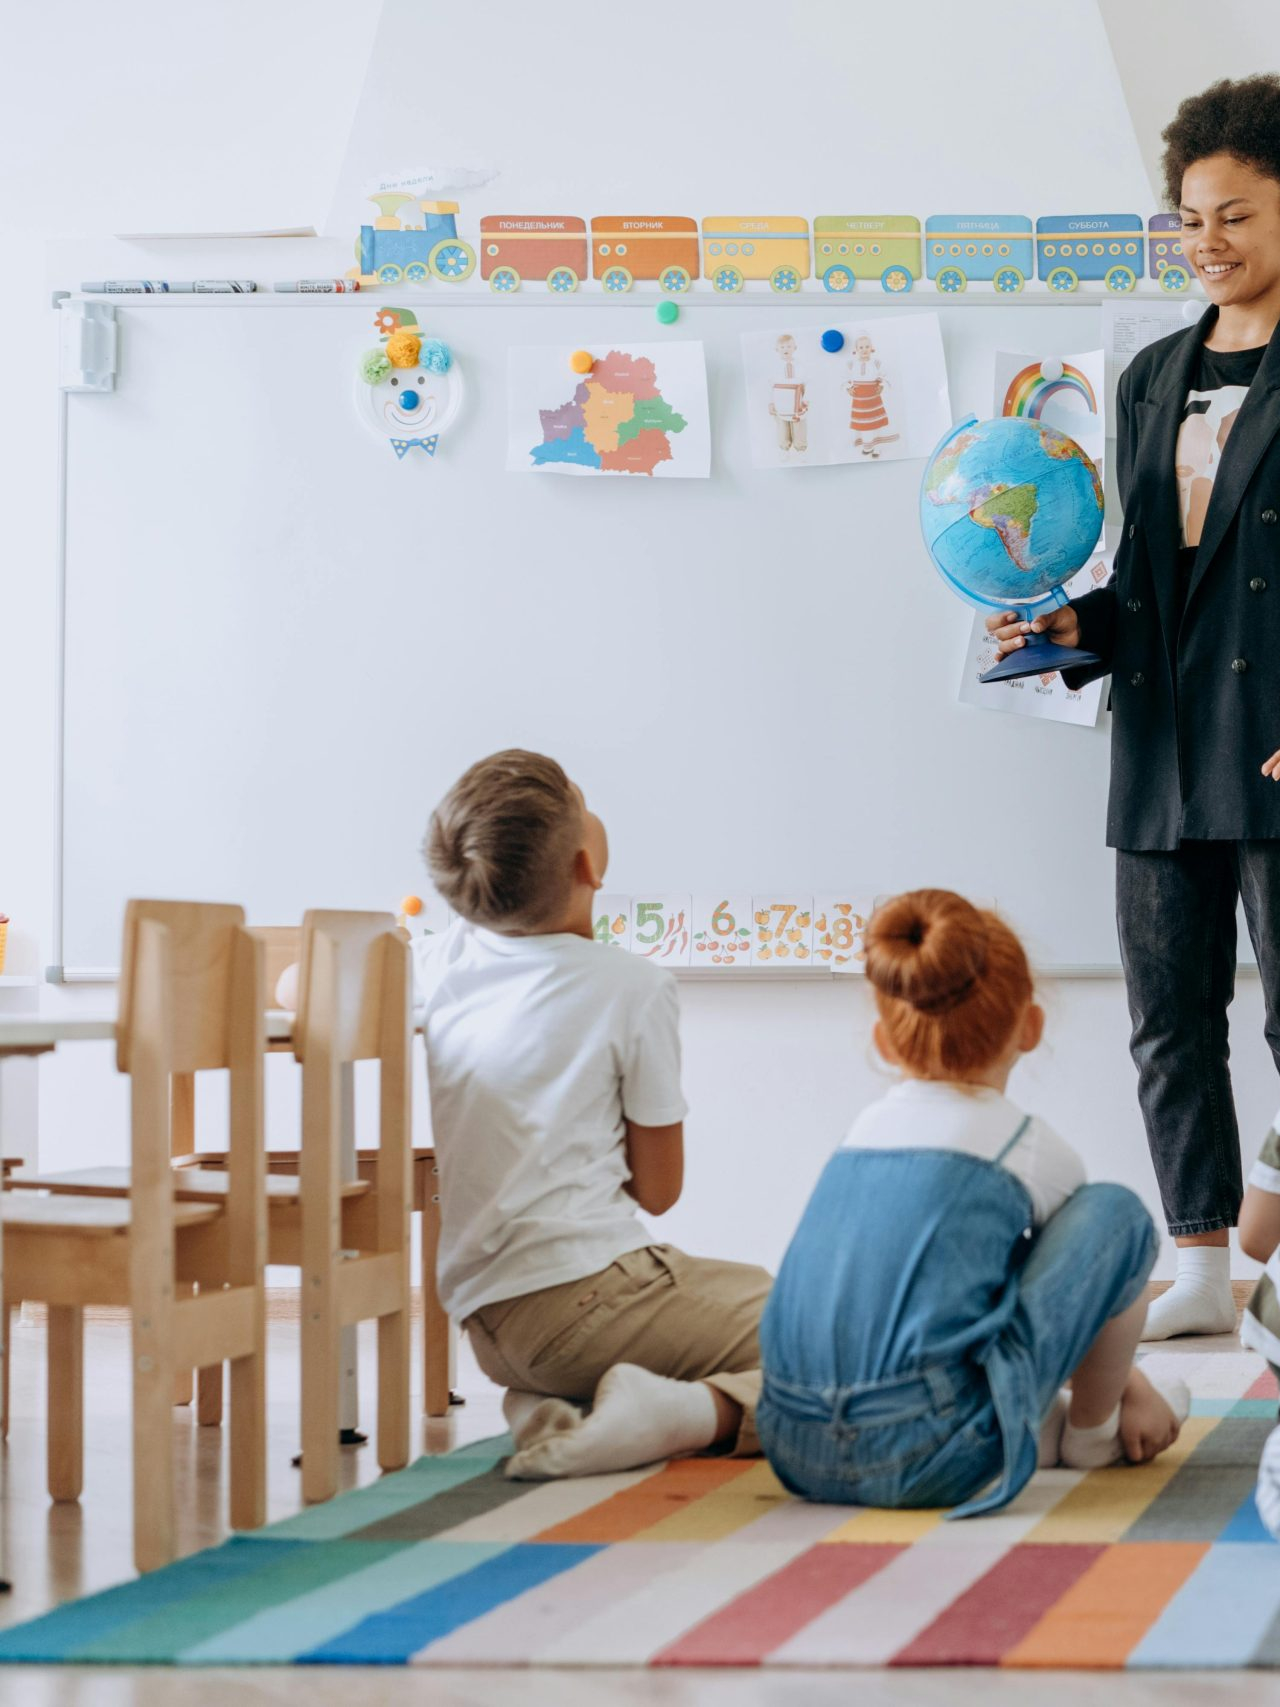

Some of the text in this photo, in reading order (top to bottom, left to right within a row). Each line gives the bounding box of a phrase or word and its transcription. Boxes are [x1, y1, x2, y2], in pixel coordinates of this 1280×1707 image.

[499, 221, 565, 230] ПОНЕДЕЛЬНИК
[623, 221, 664, 230] ВТОРНИК
[846, 221, 885, 230] ЧЕТВЕРГ
[956, 222, 1000, 231] ПЯТНИЦА
[1068, 221, 1109, 230] СУББОТА
[594, 900, 854, 950] 4 5 6 7 8
